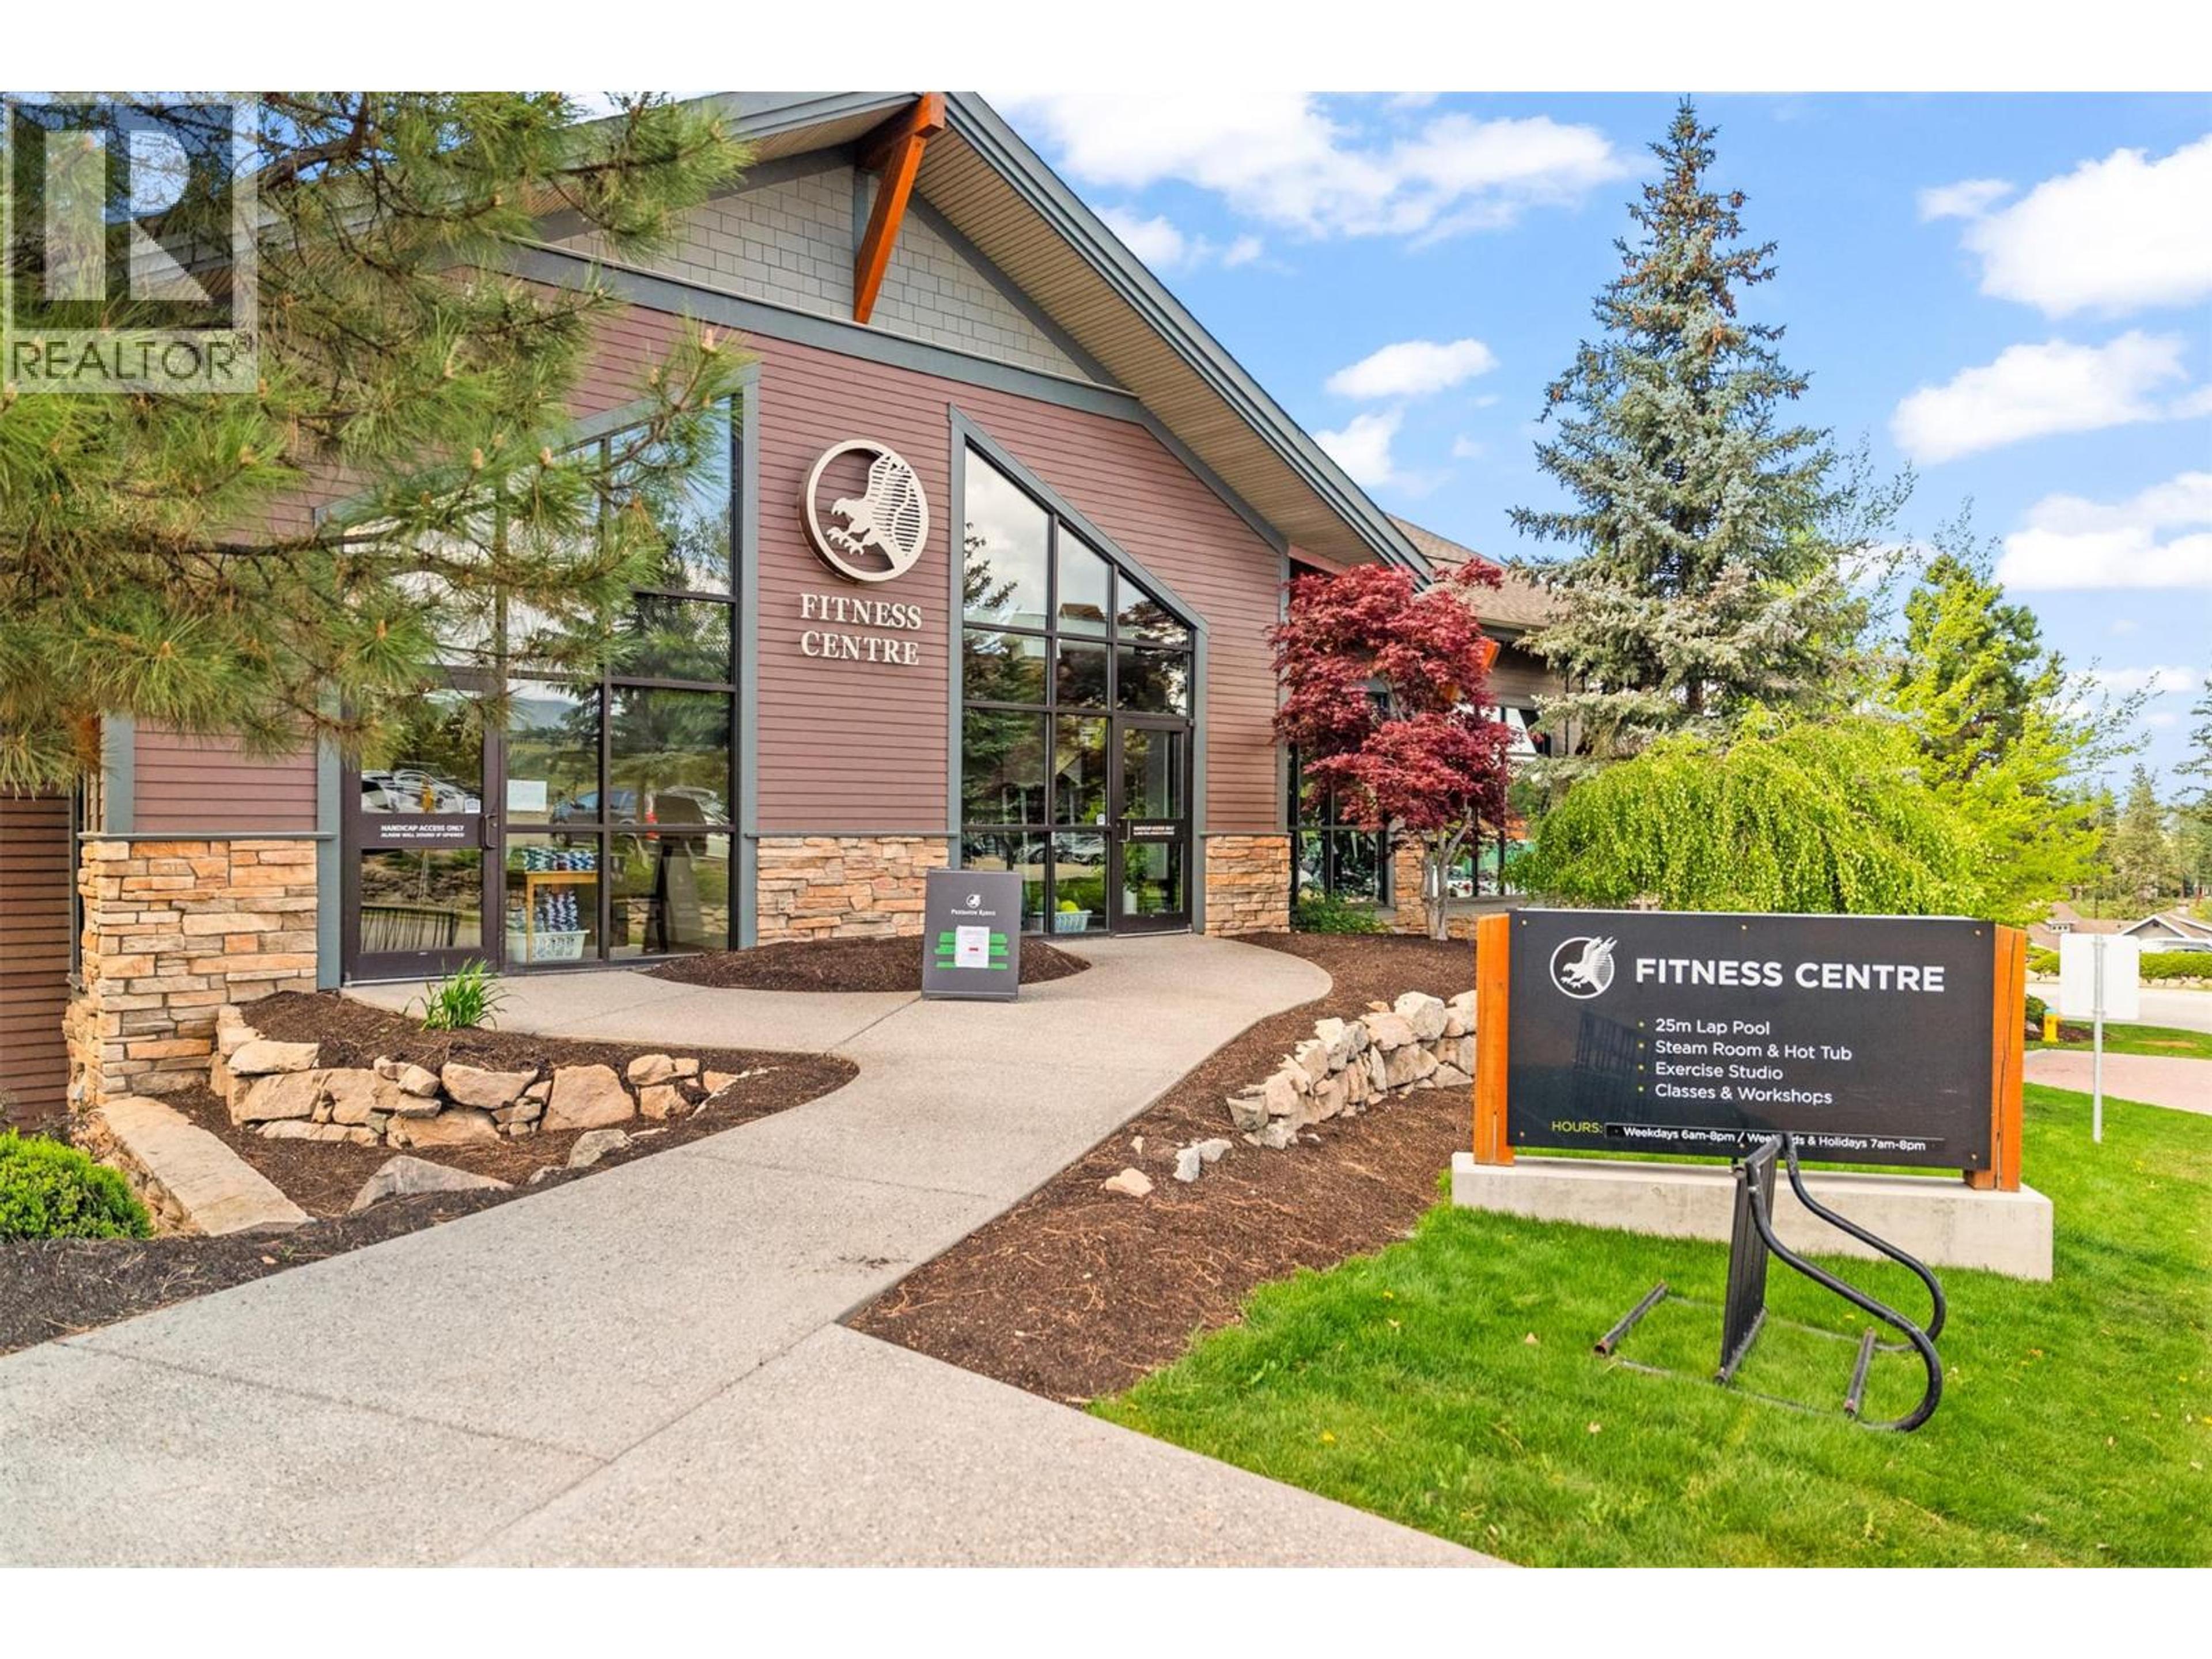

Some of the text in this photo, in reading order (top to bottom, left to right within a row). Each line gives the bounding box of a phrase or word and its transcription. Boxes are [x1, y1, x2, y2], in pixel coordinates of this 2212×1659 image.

[800, 593, 922, 630] FITNESS
[801, 630, 919, 665] CENTRE
[1636, 958, 1945, 992] FITNESS CENTRE
[1655, 1018, 1770, 1036] 25m Lap Pool
[1655, 1040, 1853, 1061] Steam Room & Hot Tub
[1655, 1062, 1783, 1080] Exercise Studio
[1655, 1084, 1833, 1105] Classes & Workshops
[1552, 1121, 1926, 1151] HOURS: Weekdays 6am-8pm / Weeds & Holidays 7am-8pm
